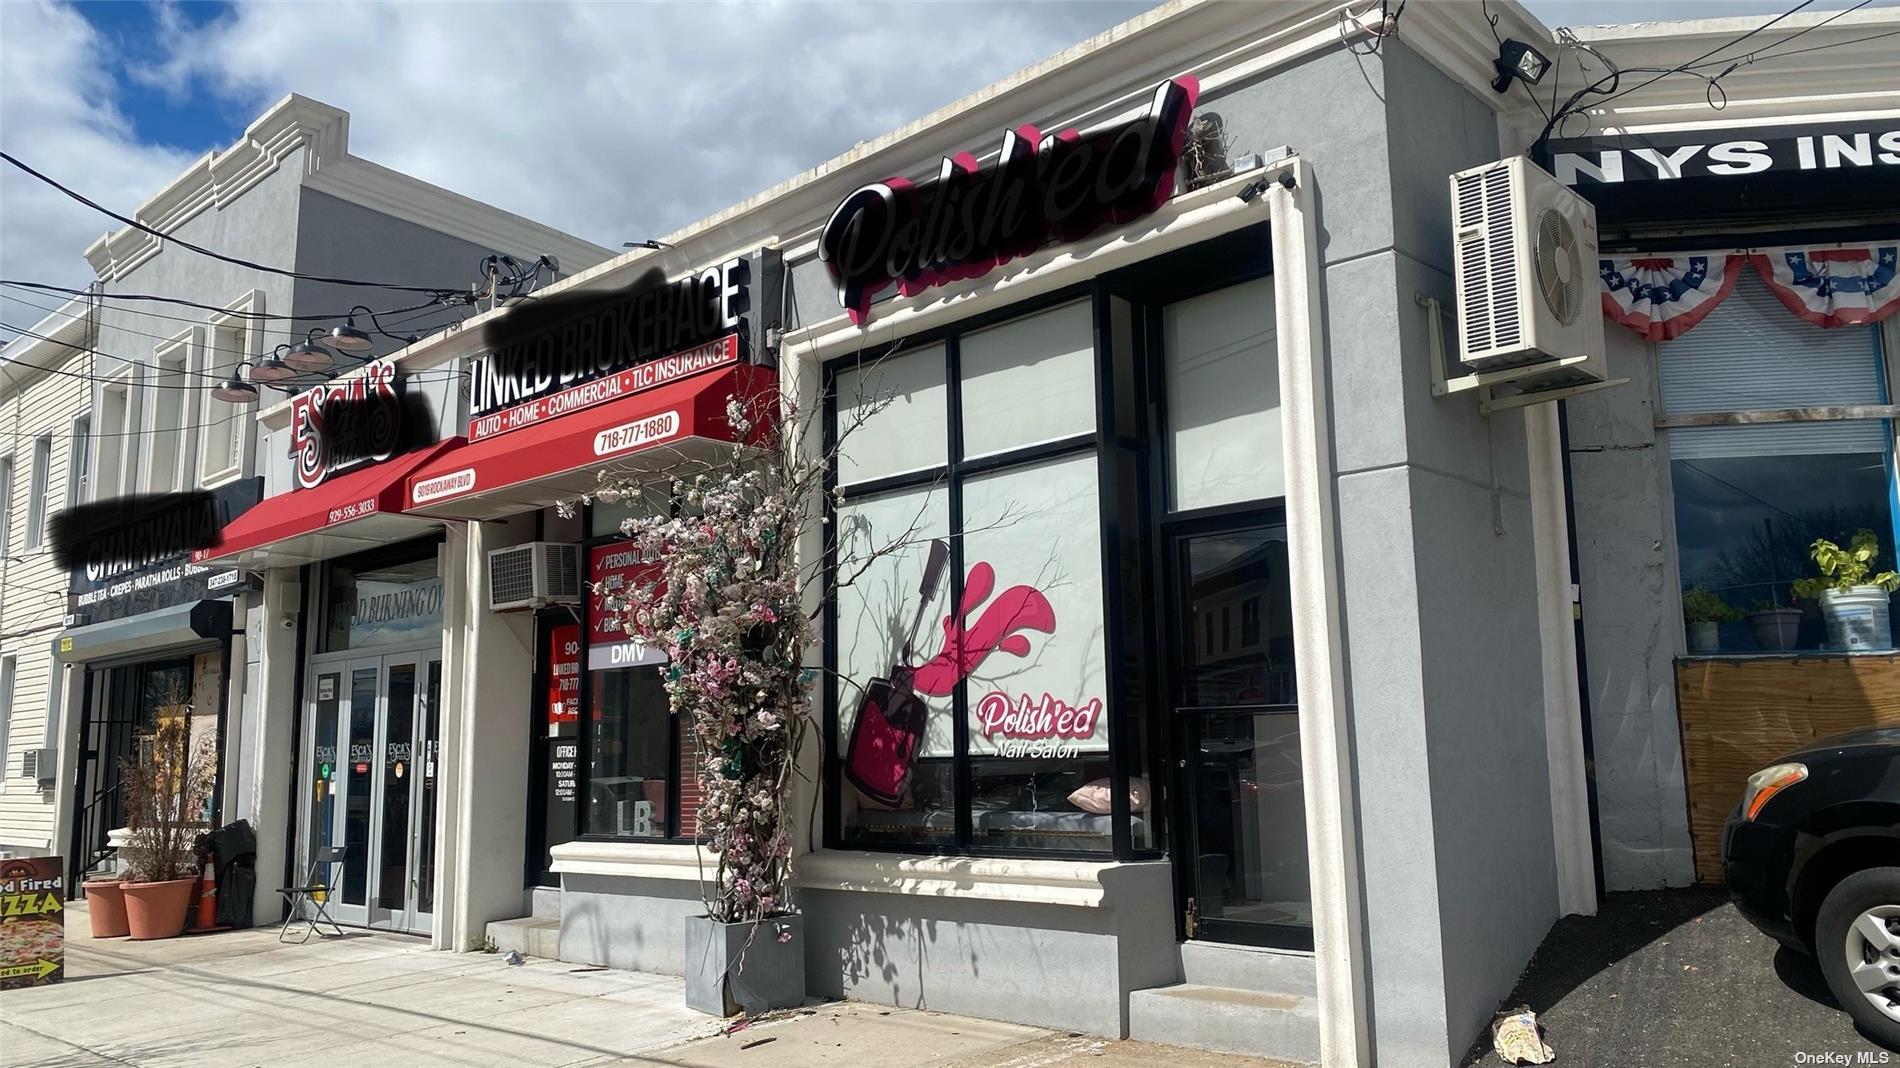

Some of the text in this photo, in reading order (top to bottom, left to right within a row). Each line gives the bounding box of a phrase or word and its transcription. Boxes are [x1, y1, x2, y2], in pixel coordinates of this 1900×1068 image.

[1554, 140, 1774, 186] NYS
[475, 339, 730, 438] AUTO HOME COMMERCIAL TLC INSURANCE
[601, 415, 672, 451] 718-777-1880
[430, 476, 458, 494] ROCKAWAY
[457, 473, 471, 488] BLVD
[329, 498, 375, 524] 929-556-3033
[605, 549, 641, 570] PERSONAL
[78, 589, 97, 607] BUBBLE
[96, 587, 108, 600] TEA
[110, 580, 132, 598] CREPES
[134, 571, 161, 591] PARATHA
[161, 566, 181, 583] ROLLS
[605, 573, 625, 591] HOME
[368, 586, 426, 625] BURNING
[611, 644, 645, 664] DMV
[976, 691, 1102, 741] Polish'ed
[993, 741, 1079, 759] Nail Salon
[20, 876, 62, 892] Fired
[23, 964, 45, 974] order
